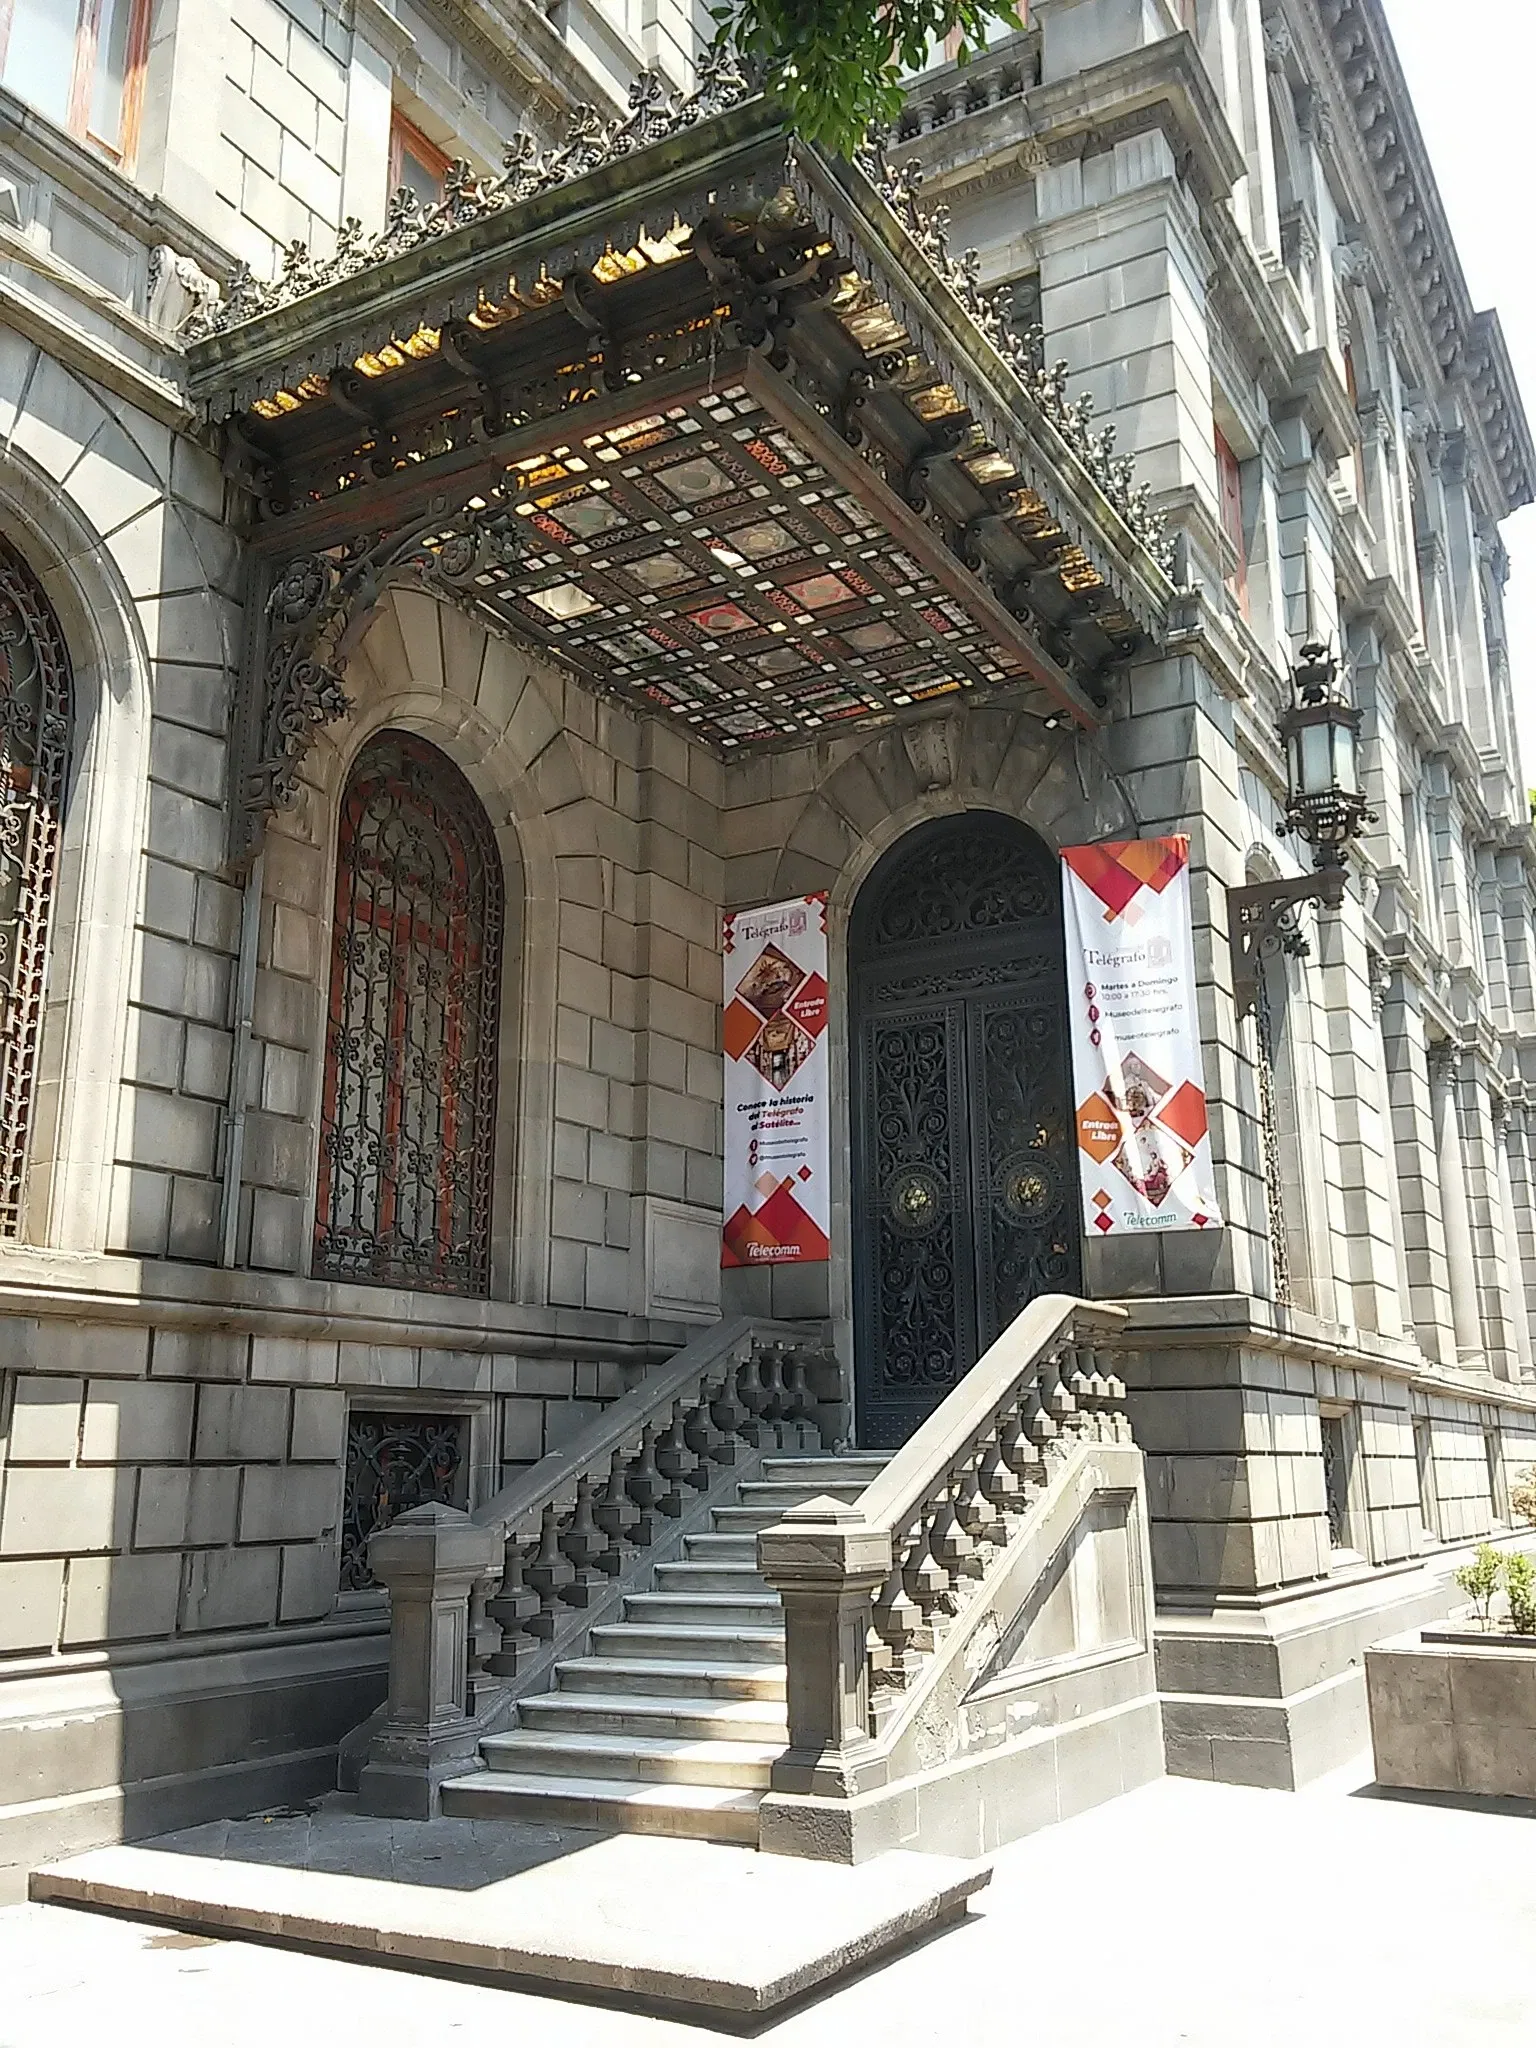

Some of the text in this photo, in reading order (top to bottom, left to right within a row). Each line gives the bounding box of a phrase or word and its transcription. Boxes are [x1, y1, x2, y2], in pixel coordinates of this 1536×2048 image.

[742, 924, 788, 940] Telégrafo
[1083, 949, 1146, 968] Telégrafo
[1101, 983, 1129, 991] Martes
[1138, 977, 1178, 987] Domingo
[794, 998, 825, 1009] Entrada
[801, 1009, 820, 1017] Libre
[737, 1093, 814, 1112] Conoce la historia
[748, 1107, 804, 1121] del Telégrafo
[1123, 1212, 1176, 1226] Telecomm
[746, 1242, 801, 1257] Telecomm
